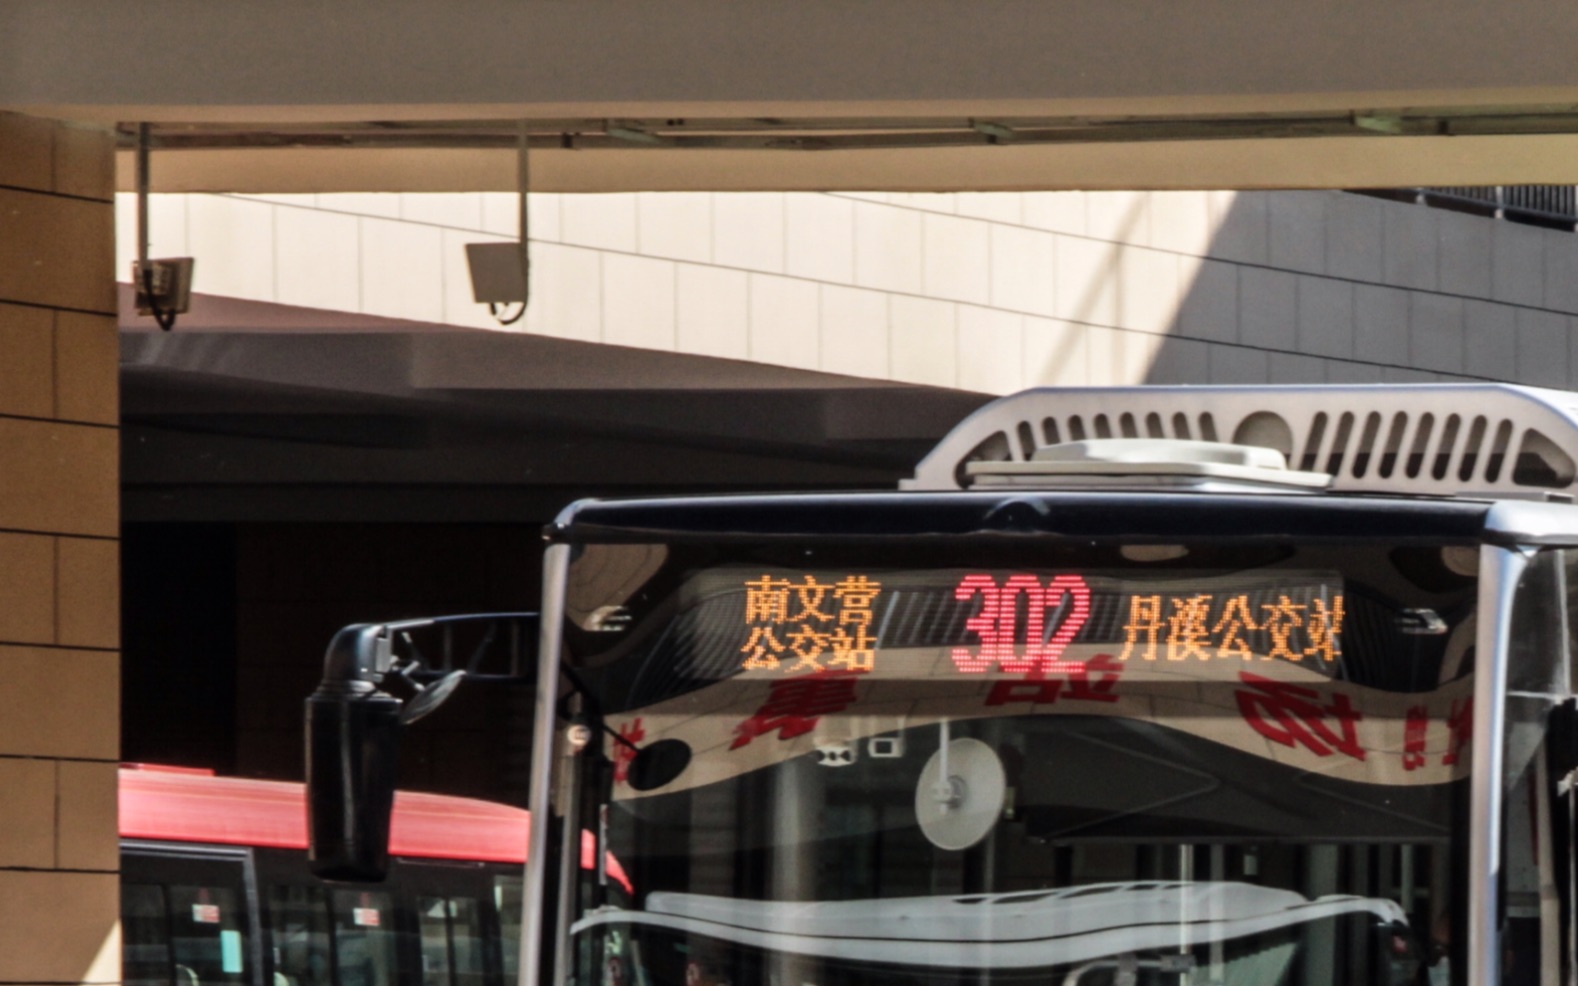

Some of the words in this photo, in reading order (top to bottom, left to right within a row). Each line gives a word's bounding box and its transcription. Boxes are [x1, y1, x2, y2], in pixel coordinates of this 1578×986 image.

[745, 575, 881, 624] 南文营
[952, 574, 1091, 673] 302
[1118, 594, 1346, 662] 丹溪公交站
[741, 624, 877, 672] 公交站
